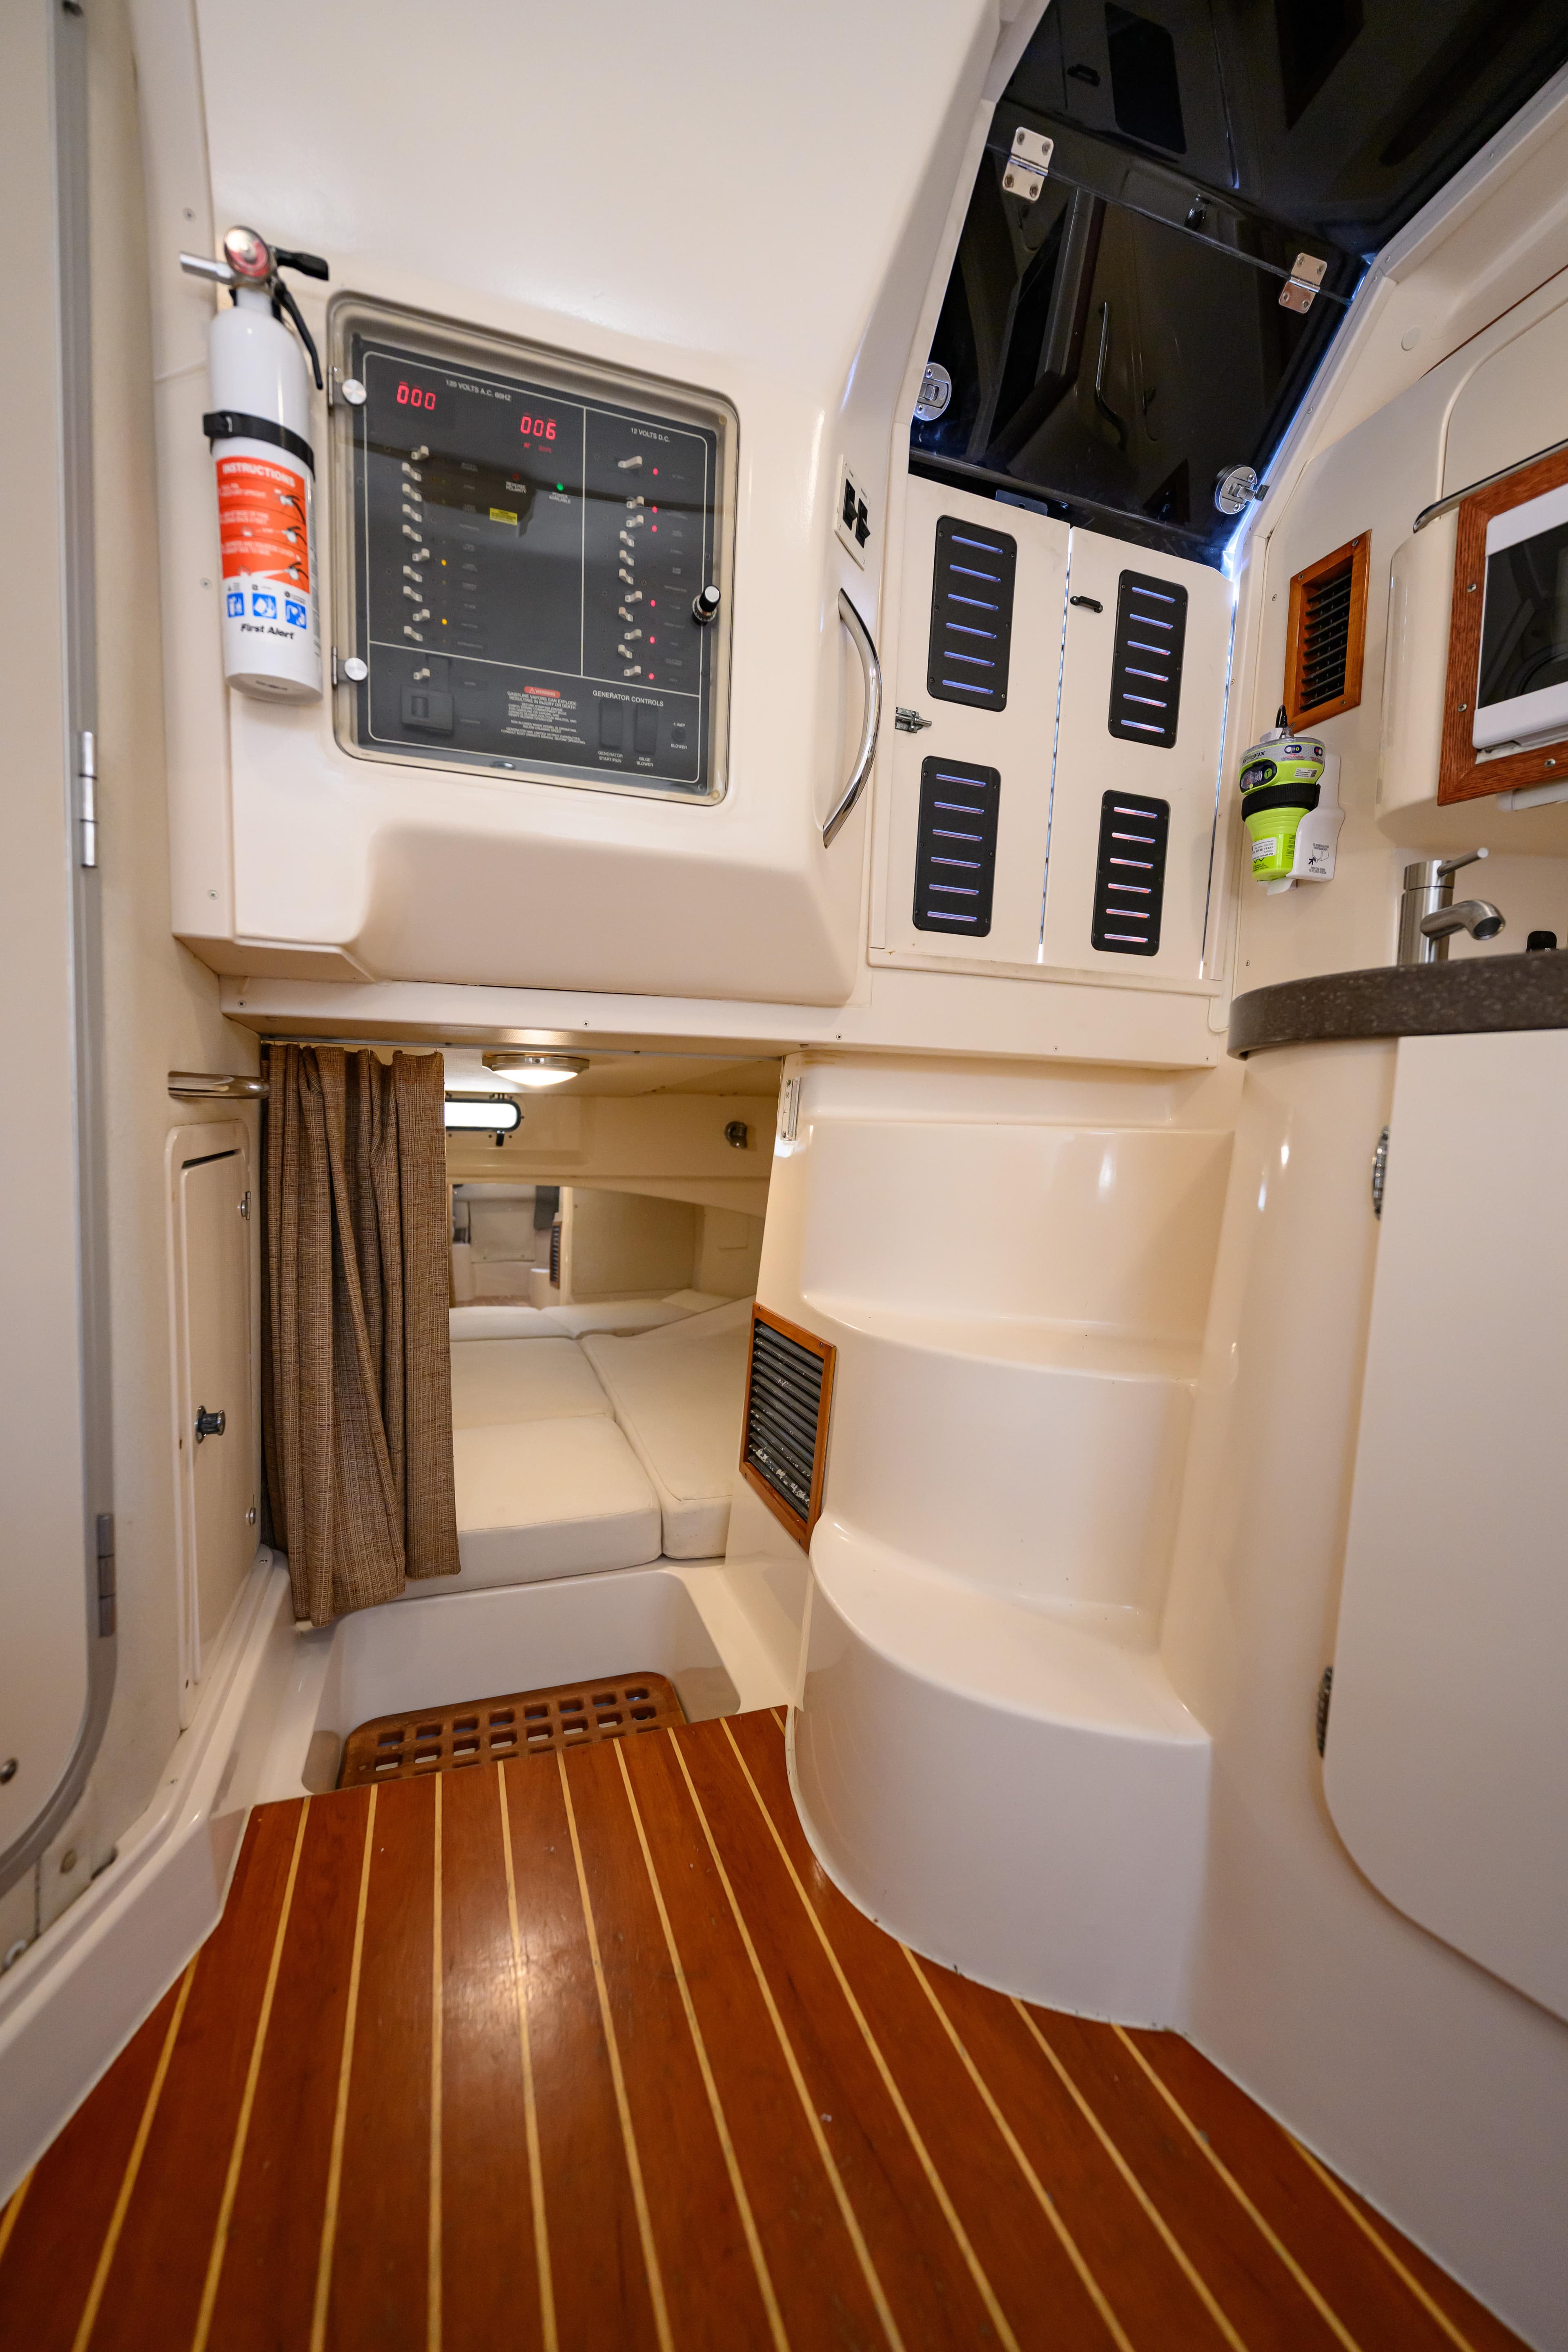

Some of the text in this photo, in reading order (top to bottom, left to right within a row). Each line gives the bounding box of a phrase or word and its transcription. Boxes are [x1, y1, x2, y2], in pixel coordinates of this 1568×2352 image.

[396, 385, 436, 410] 000
[446, 379, 457, 388] 120
[458, 381, 479, 394] VOLTS
[480, 388, 494, 398] A.C.
[520, 416, 557, 441] 006
[638, 429, 657, 439] VOLTS
[658, 434, 670, 442] D.C.
[223, 462, 295, 488] INSTRUCTIONS
[241, 623, 294, 639] First Alert
[592, 690, 664, 706] GENERATOR CONTROLS
